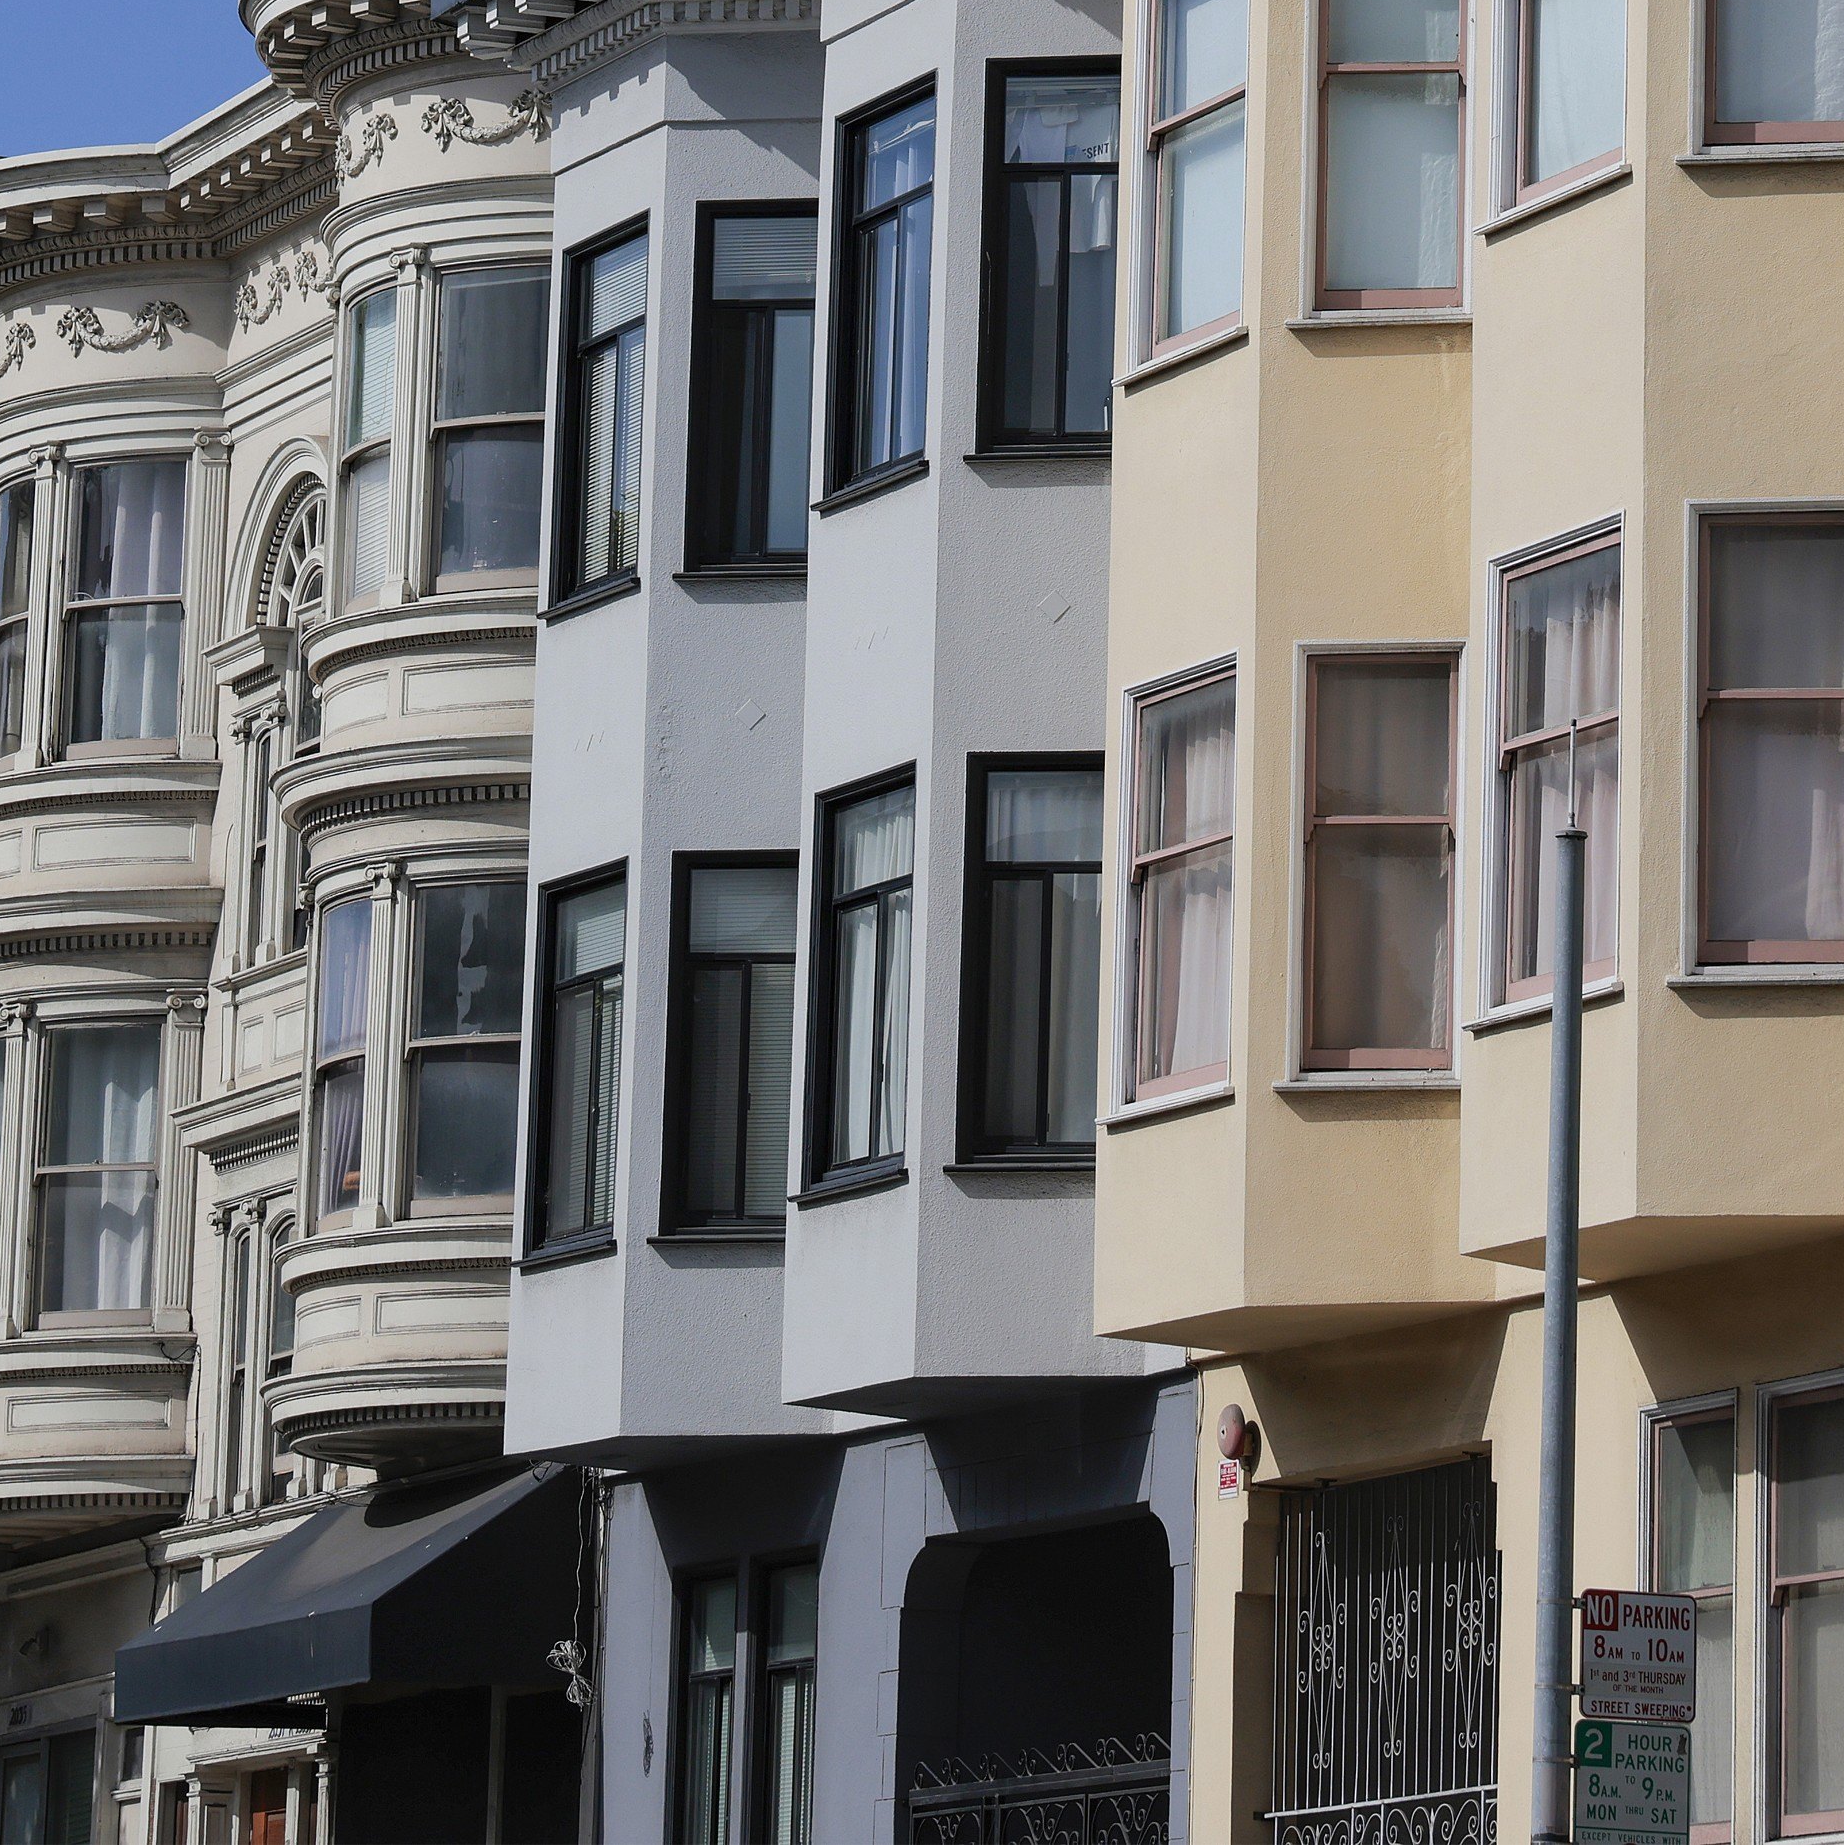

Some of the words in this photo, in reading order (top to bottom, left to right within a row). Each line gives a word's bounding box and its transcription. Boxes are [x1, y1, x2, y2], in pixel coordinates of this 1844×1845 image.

[1587, 1594, 1614, 1626] NO
[1623, 1604, 1690, 1631] PARKING
[1631, 1651, 1641, 1661] TO
[1590, 1668, 1600, 1680] 1st
[1602, 1671, 1619, 1682] and
[1623, 1670, 1636, 1682] 3rd
[1638, 1671, 1687, 1686] THURSDAY
[1613, 1684, 1622, 1692] OF
[1625, 1685, 1638, 1693] THE
[1640, 1686, 1664, 1694] MONTH
[1591, 1700, 1629, 1714] STREET
[1634, 1702, 1686, 1718] SWEEPING
[1584, 1728, 1604, 1760] 2
[1628, 1734, 1672, 1753] HOUR
[1615, 1753, 1685, 1773] PARKING
[1625, 1775, 1636, 1785] TO
[1586, 1803, 1616, 1821] MON
[1625, 1805, 1644, 1815] THRU
[1650, 1807, 1677, 1824] SAT
[1581, 1831, 1611, 1841] EXCEPT
[1618, 1833, 1656, 1844] VEHICLES
[1662, 1834, 1681, 1845] WITH
